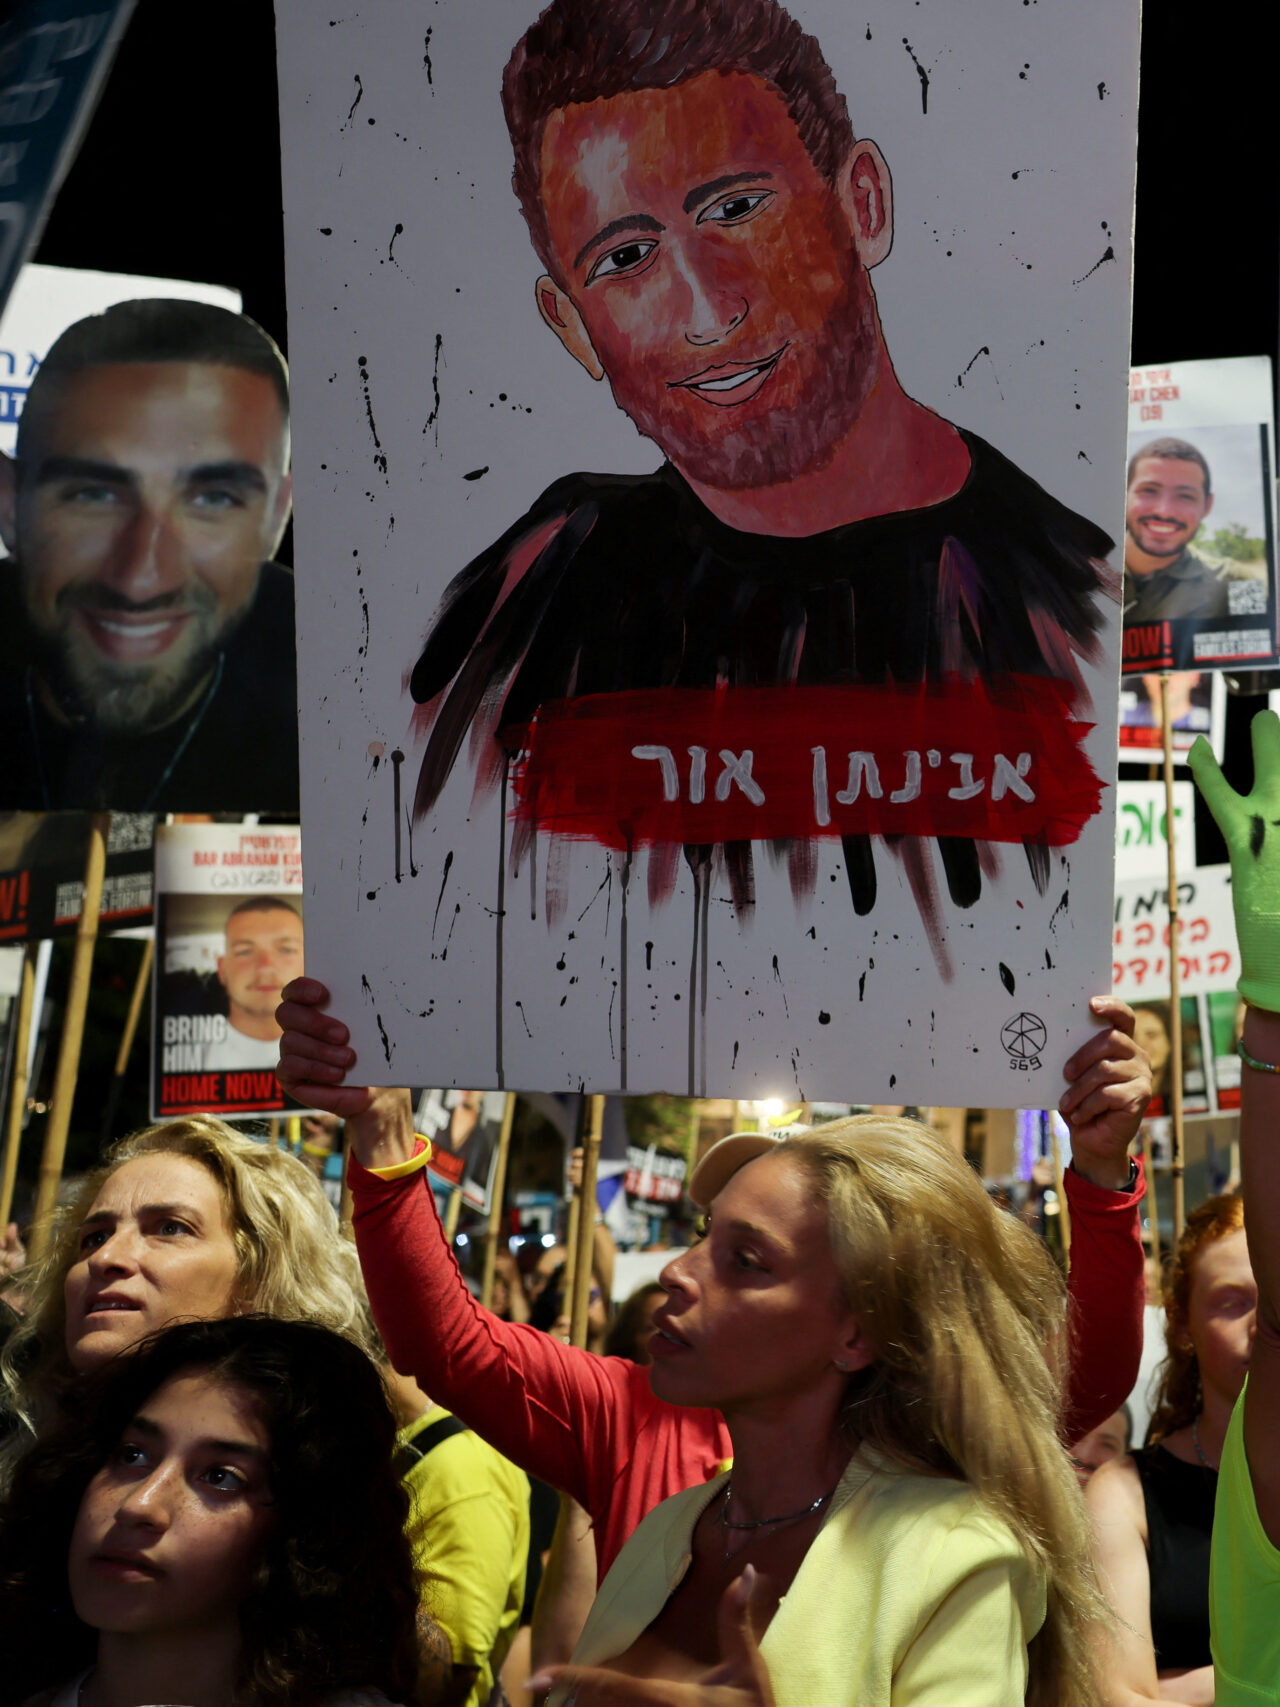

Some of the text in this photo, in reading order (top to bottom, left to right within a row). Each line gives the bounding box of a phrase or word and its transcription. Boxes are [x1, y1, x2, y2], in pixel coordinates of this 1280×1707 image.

[631, 744, 1036, 827] אבינתן אור
[163, 1014, 227, 1044] BRING
[163, 1043, 204, 1074] HIM
[162, 1072, 283, 1105] HOME NOW!
